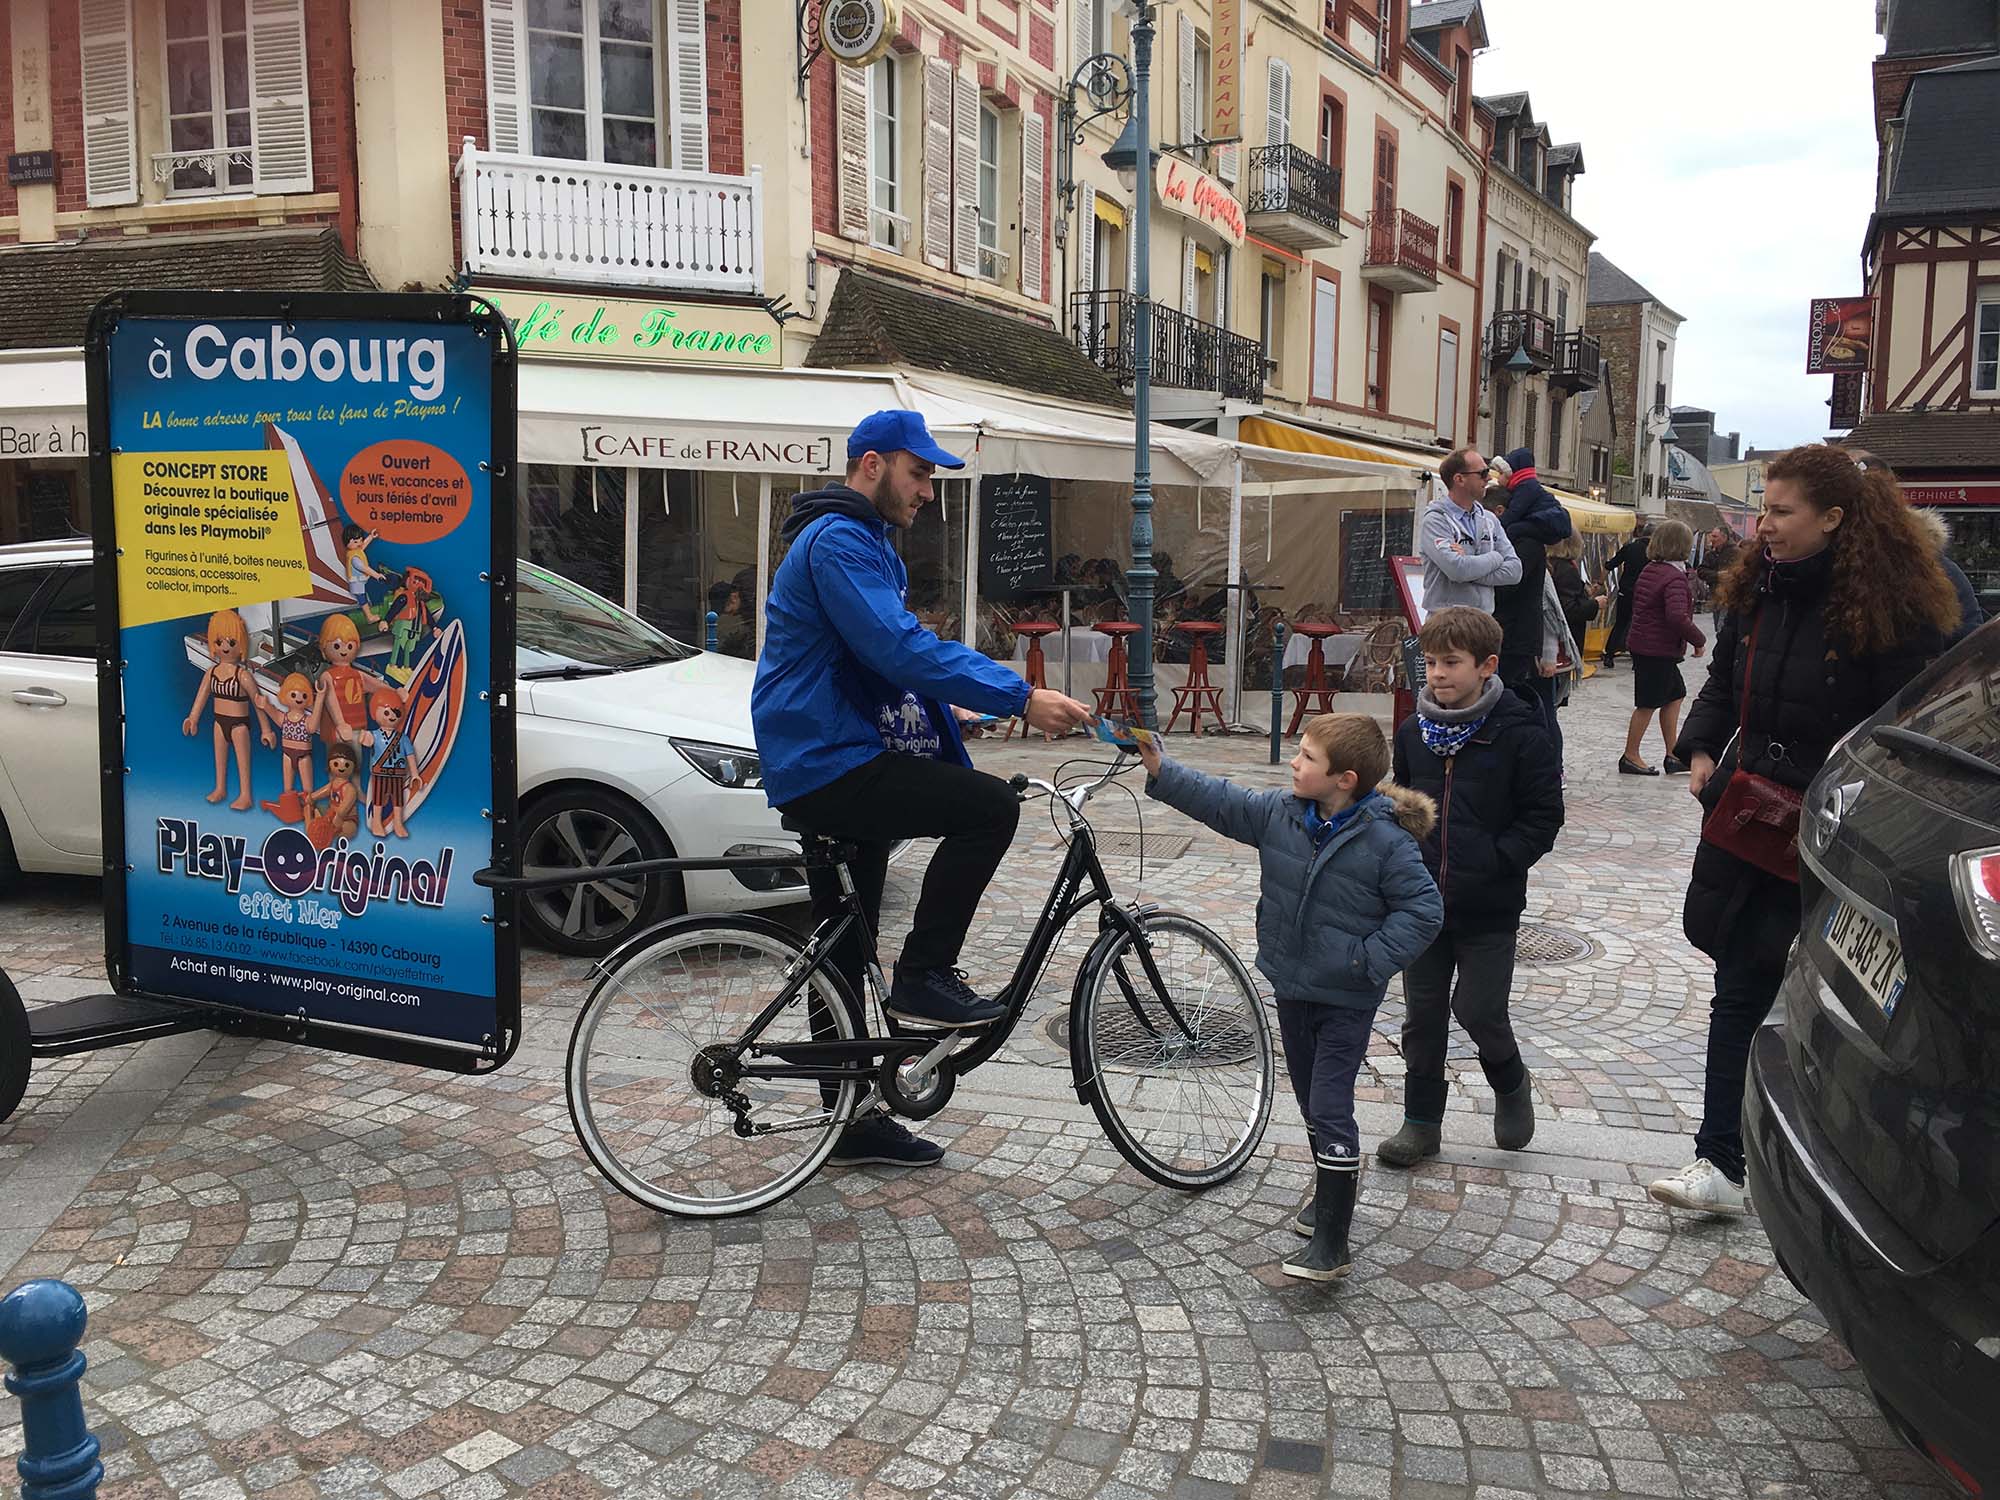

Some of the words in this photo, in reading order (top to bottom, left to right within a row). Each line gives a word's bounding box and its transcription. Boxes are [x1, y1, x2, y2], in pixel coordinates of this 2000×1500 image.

[844, 38, 865, 48] UNTER
[1215, 0, 1234, 135] STAURANT
[1163, 161, 1186, 202] La
[571, 306, 620, 344] de
[633, 308, 774, 354] France
[148, 337, 172, 379] à
[185, 324, 446, 401] Cabourg
[142, 411, 162, 429] LA
[166, 413, 200, 428] bonne
[203, 412, 249, 426] adresse
[252, 412, 282, 429] pour
[286, 408, 312, 422] tous
[316, 405, 336, 420] les
[338, 403, 370, 423] fans
[373, 401, 388, 417] de
[393, 399, 447, 420] Playmo
[452, 396, 461, 416] !
[0, 427, 40, 453] Bar
[49, 425, 63, 452] à
[382, 454, 431, 470] Ouvert
[680, 444, 702, 460] de
[143, 461, 216, 479] CONCEPT
[220, 465, 268, 481] STORE
[349, 472, 365, 485] les
[368, 473, 388, 488] WE,
[391, 478, 449, 489] vacances
[452, 477, 464, 489] et
[143, 482, 210, 499] Découvrez
[213, 486, 226, 499] la
[230, 487, 289, 505] boutique
[356, 491, 384, 504] jours
[387, 491, 417, 505] fériés
[421, 493, 457, 506] d'avril
[144, 503, 200, 520] originale
[204, 505, 278, 521] spécialisée
[370, 507, 378, 520] à
[381, 509, 444, 524] septembre
[145, 522, 176, 536] dans
[179, 523, 197, 537] les
[145, 550, 188, 564] Figurines
[190, 550, 197, 562] à
[200, 551, 232, 566] l'unité,
[266, 559, 305, 570] neuves,
[146, 567, 198, 579] occasions,
[200, 569, 260, 582] accessoires,
[146, 581, 191, 593] collector,
[193, 583, 237, 596] imports...
[239, 891, 293, 924] effet
[298, 899, 342, 929] Mer
[162, 914, 170, 926] 2
[172, 915, 219, 934] Avenue
[223, 923, 239, 936] de
[242, 924, 254, 939] la
[257, 926, 327, 949] république
[340, 938, 378, 957] 14390
[381, 944, 442, 969] Cabourg
[170, 956, 207, 974] Achat
[210, 965, 226, 977] en
[229, 965, 260, 983] ligne
[270, 973, 420, 1006] www.play-original.com
